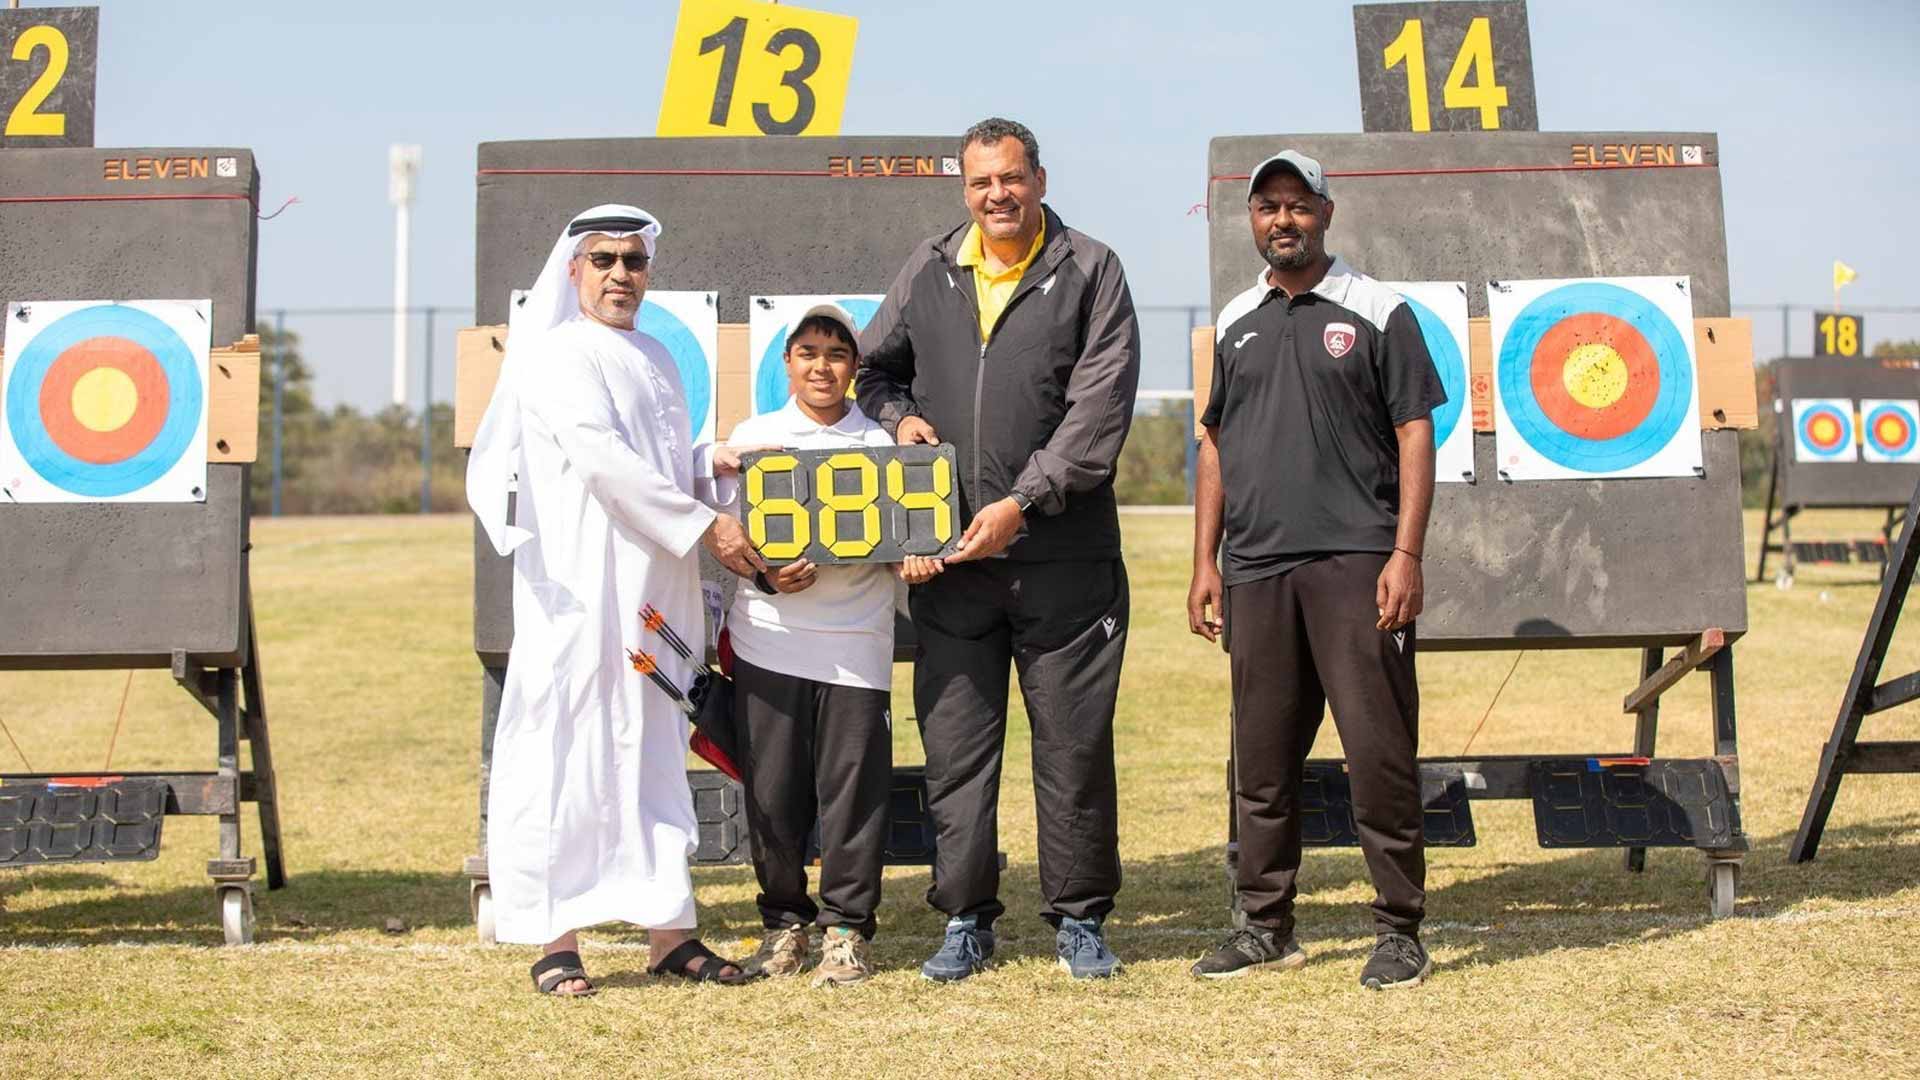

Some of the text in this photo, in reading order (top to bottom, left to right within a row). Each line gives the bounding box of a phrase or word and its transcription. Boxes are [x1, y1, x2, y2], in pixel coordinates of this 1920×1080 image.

[698, 16, 821, 135] 13
[1384, 17, 1508, 132] 14
[104, 157, 208, 180] ELEVEN
[828, 156, 934, 176] ELEVEN
[1571, 144, 1676, 165] ELEVEN
[1820, 315, 1857, 357] 18
[746, 453, 952, 559] 684
